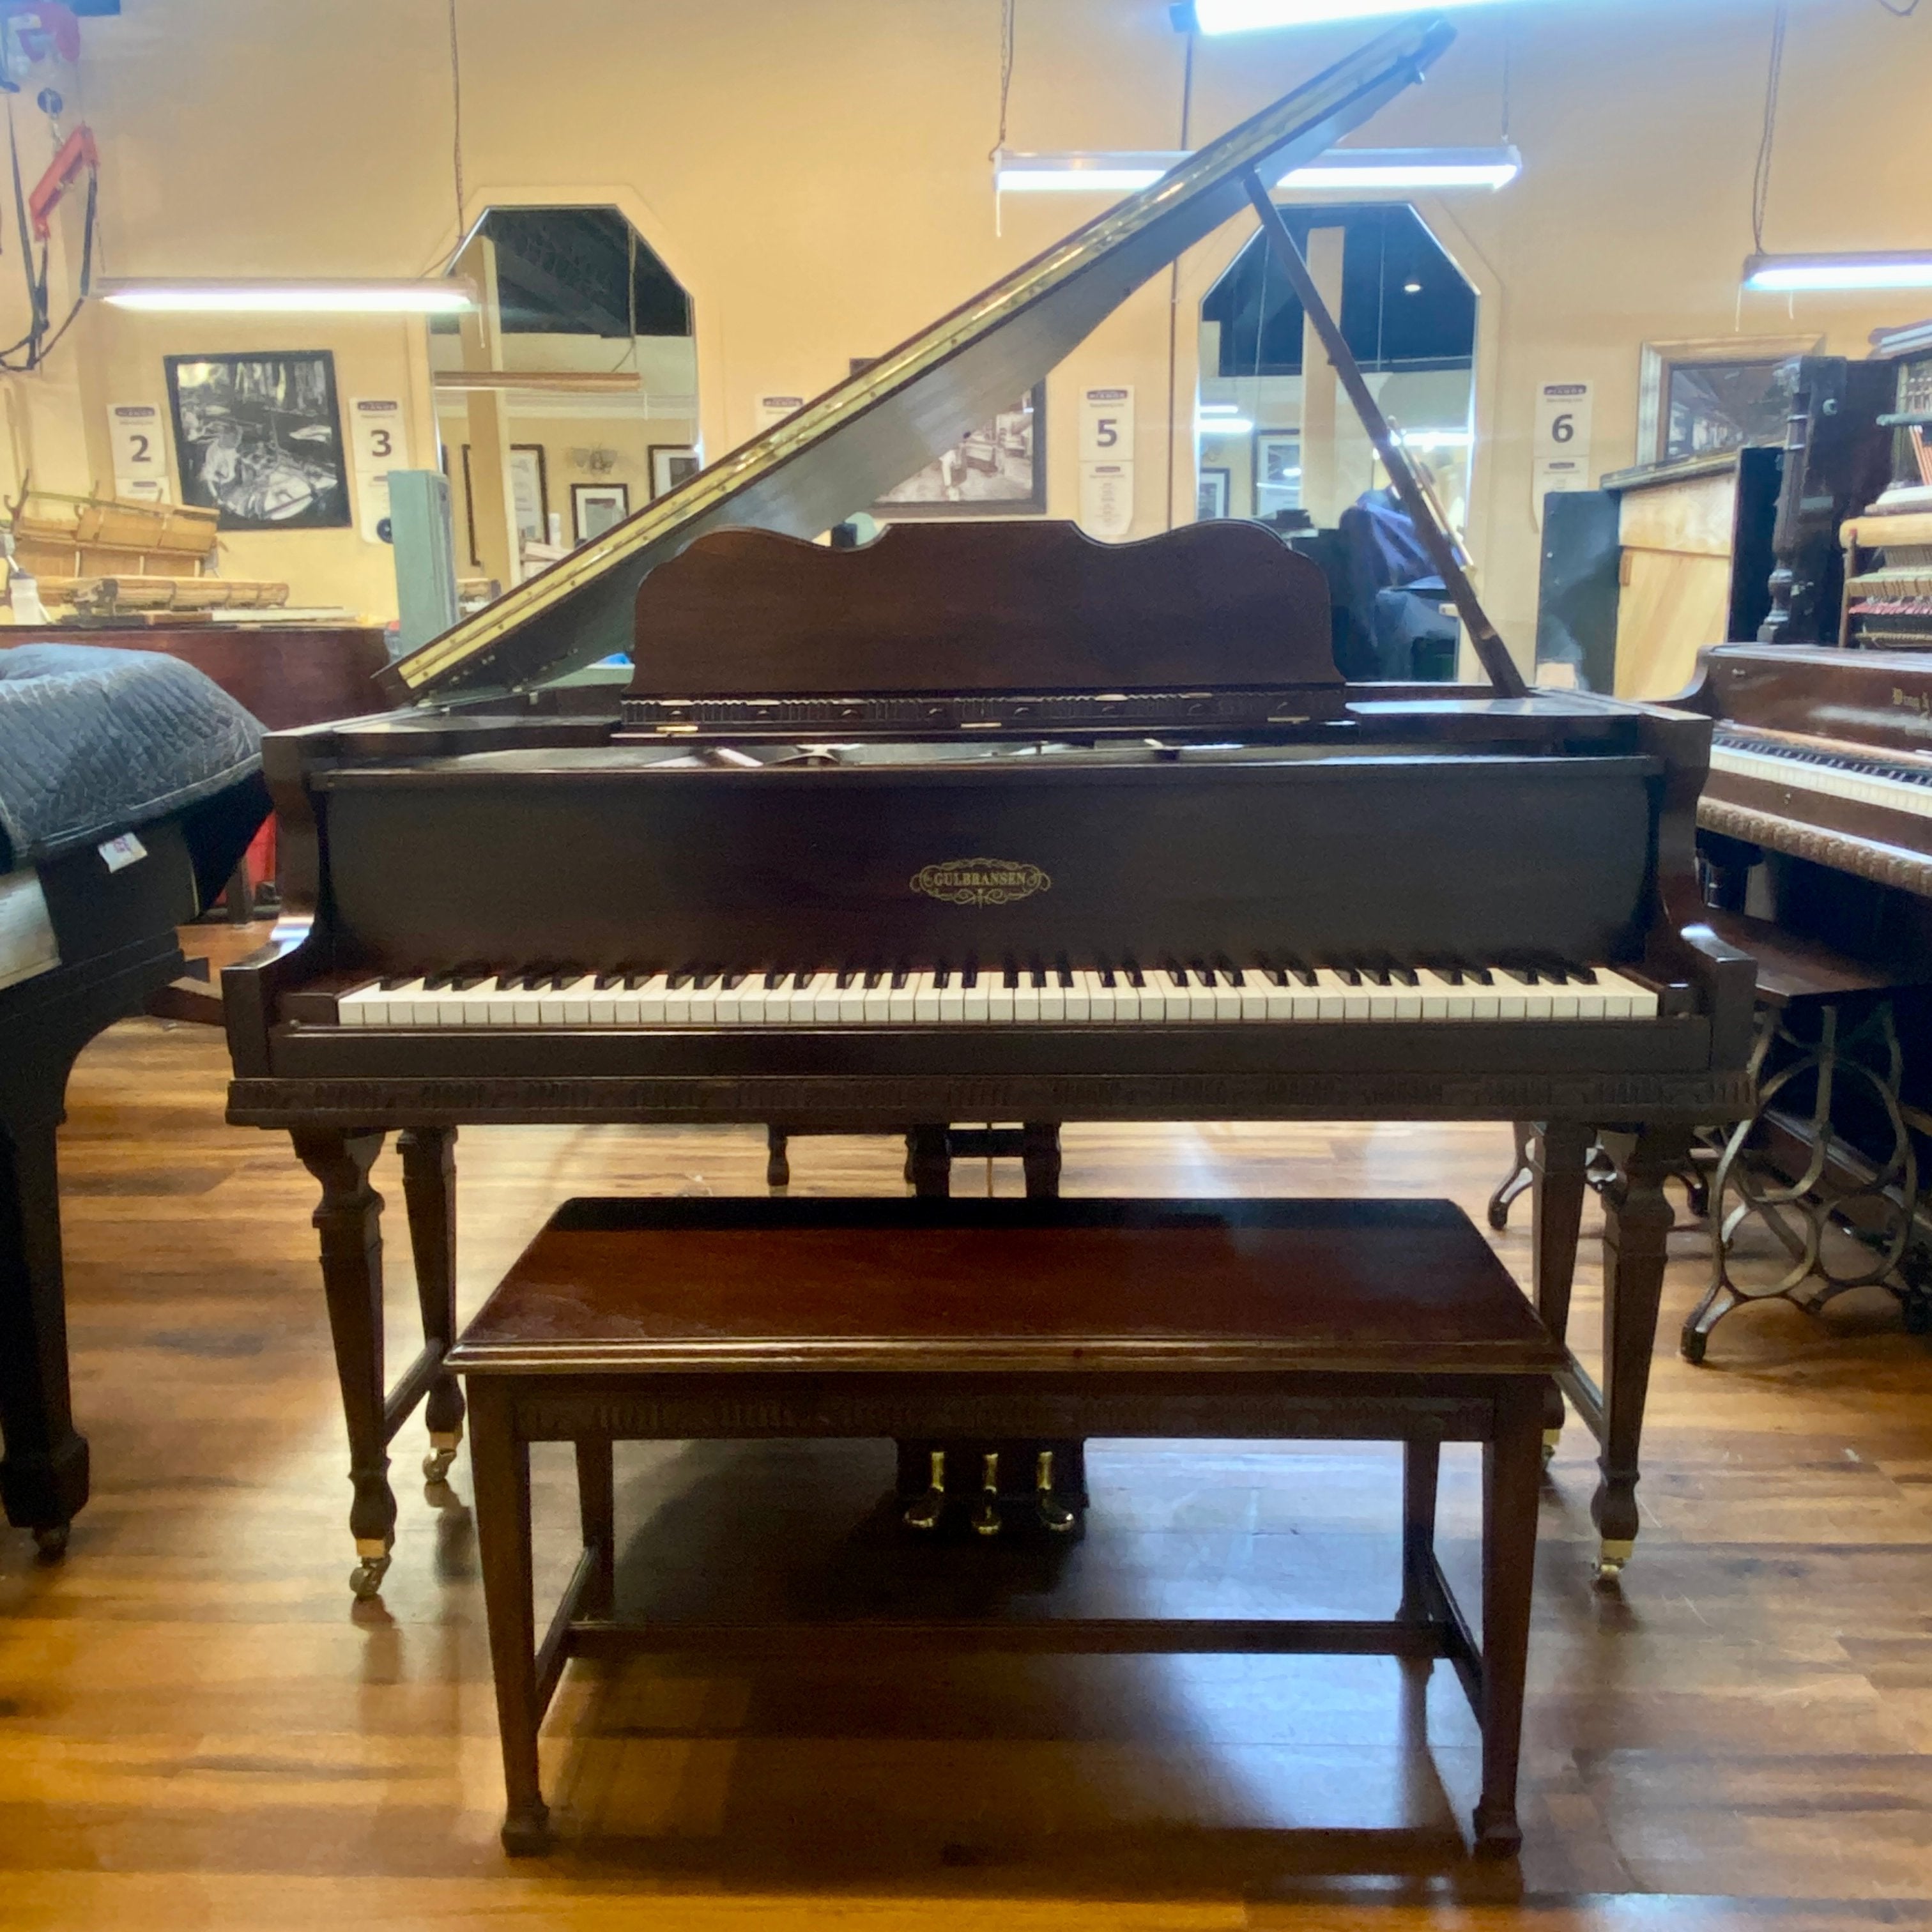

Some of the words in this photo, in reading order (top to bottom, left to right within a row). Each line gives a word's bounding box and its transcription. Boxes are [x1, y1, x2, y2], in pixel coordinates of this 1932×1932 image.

[1096, 419, 1117, 448] 5
[1552, 414, 1574, 443] 6
[130, 435, 151, 462] 2
[370, 429, 392, 457] 3
[933, 872, 1026, 886] GULBRANSEN
